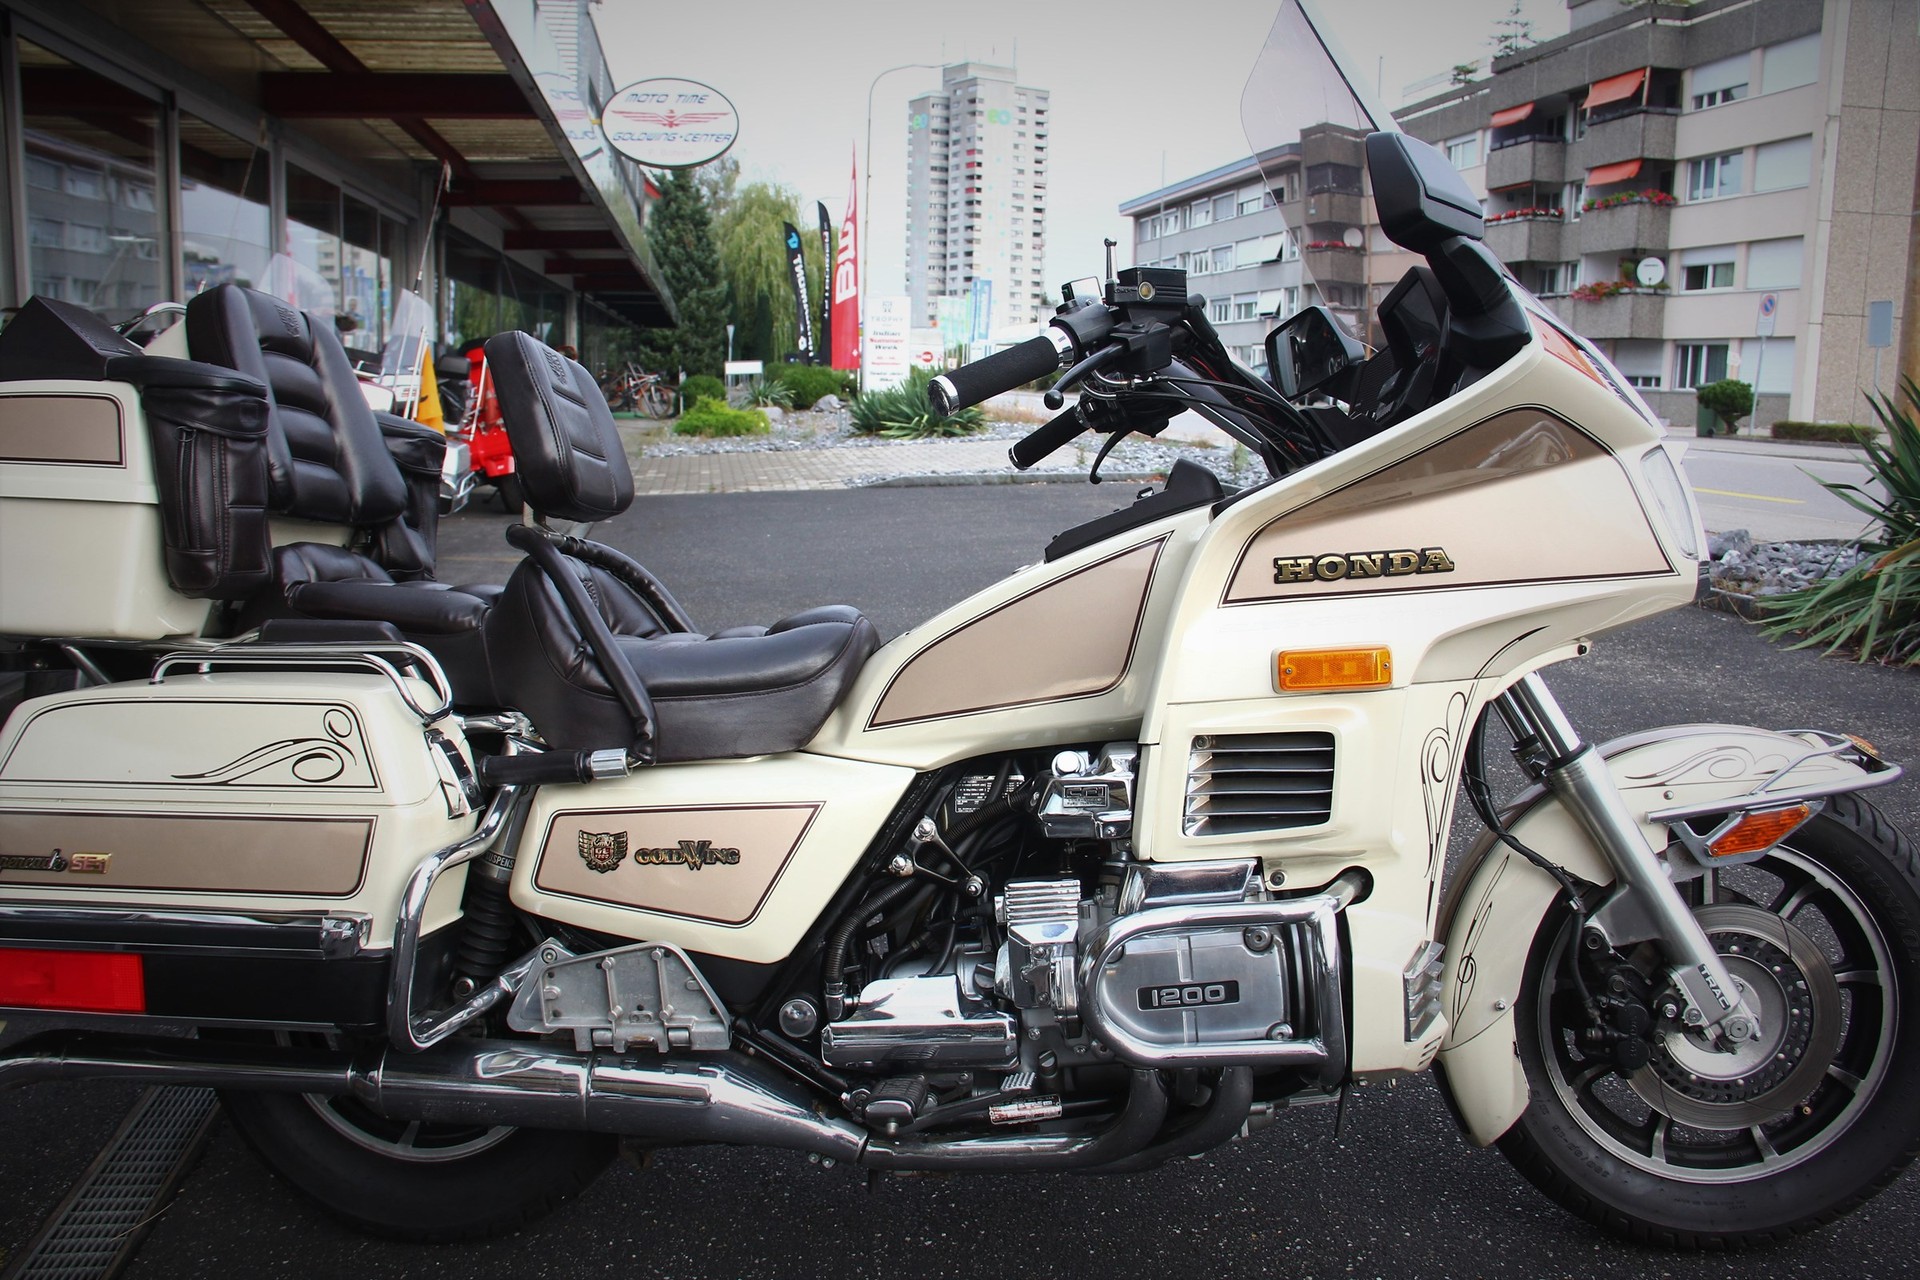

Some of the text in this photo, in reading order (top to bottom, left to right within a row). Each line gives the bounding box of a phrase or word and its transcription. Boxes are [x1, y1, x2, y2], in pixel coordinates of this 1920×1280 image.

[625, 93, 710, 104] MOTO TIME
[1275, 549, 1454, 582] HONDA
[1152, 985, 1225, 1006] 1200
[1701, 965, 1730, 1009] TRAC
